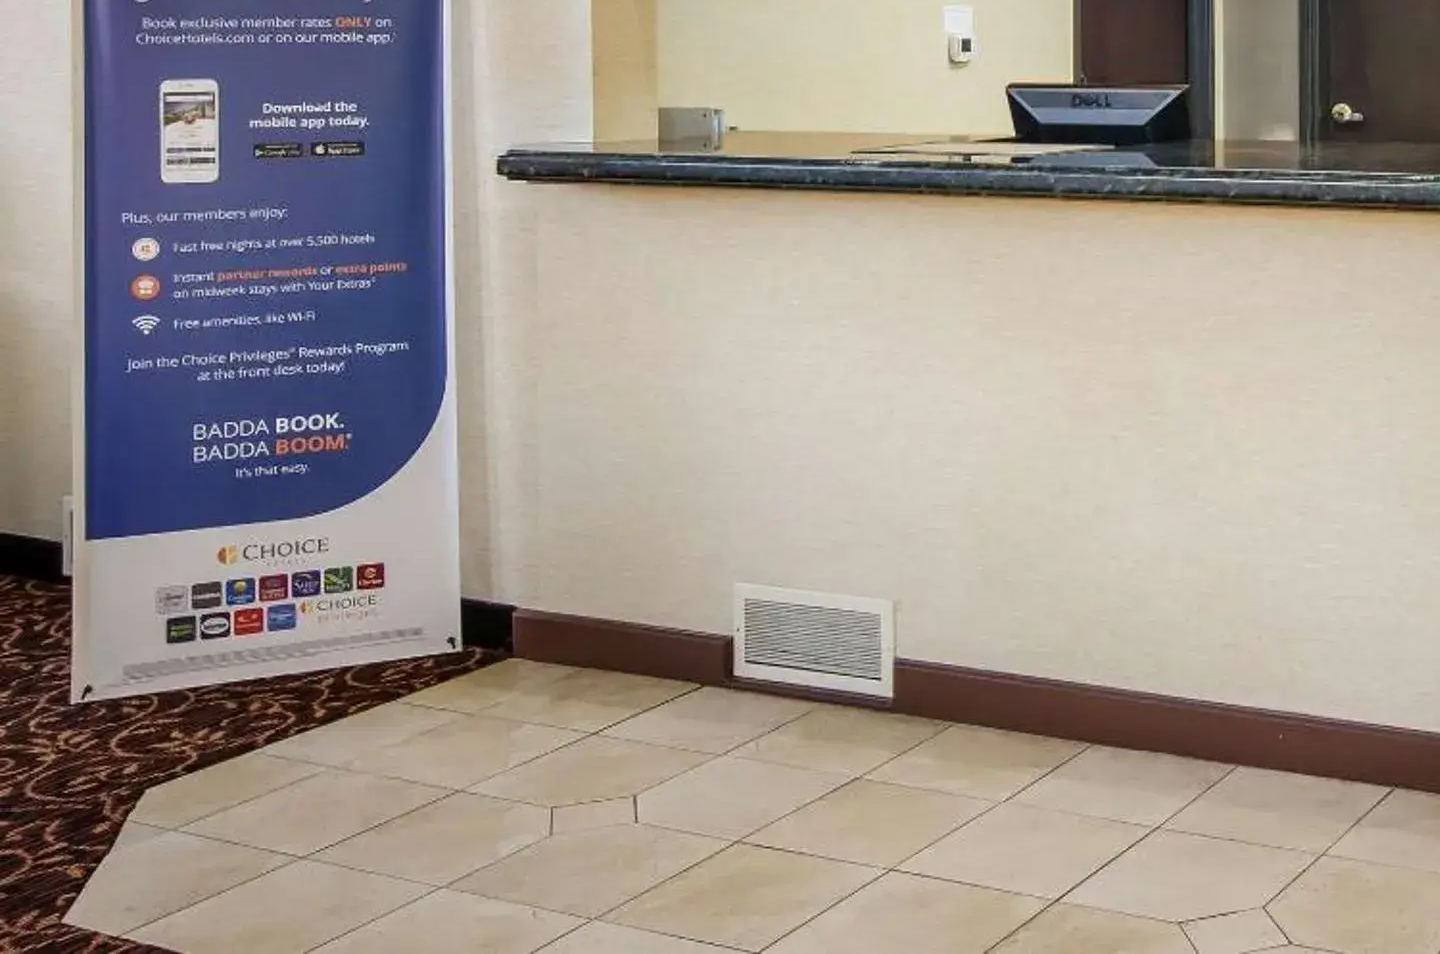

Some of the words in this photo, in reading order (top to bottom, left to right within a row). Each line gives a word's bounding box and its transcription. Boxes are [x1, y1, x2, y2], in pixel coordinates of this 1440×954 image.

[142, 17, 177, 29] Book
[180, 17, 238, 28] exclusive
[241, 16, 297, 28] member
[301, 18, 332, 28] rates
[335, 16, 371, 27] ONLY
[375, 18, 393, 28] on
[257, 35, 273, 44] or
[275, 34, 292, 44] on
[295, 33, 319, 44] our
[320, 32, 364, 44] mobile
[262, 102, 332, 114] Download
[334, 101, 358, 113] the
[1072, 93, 1112, 108] DELL
[249, 116, 297, 128] mobile
[300, 117, 326, 129] app
[328, 115, 370, 127] today.
[121, 212, 153, 225] Plus,
[156, 212, 180, 222] our
[183, 208, 247, 222] members
[173, 272, 214, 283] Instant
[320, 266, 334, 275] or
[191, 285, 246, 297] midweek
[248, 284, 279, 296] stays
[280, 282, 306, 293] with
[307, 280, 334, 291] Your
[173, 319, 200, 330] Free
[156, 355, 179, 367] the
[181, 352, 227, 366] Choice
[298, 344, 353, 358] Rewards
[355, 342, 410, 356] Program
[213, 368, 236, 380] the
[238, 365, 271, 378] front
[273, 363, 304, 376] desk
[193, 419, 270, 441] BADDA
[275, 412, 345, 434] BOOK.
[193, 440, 270, 463] BADDA
[254, 465, 279, 477] that
[243, 538, 330, 560] CHOICE
[316, 595, 377, 611] CHOICE
